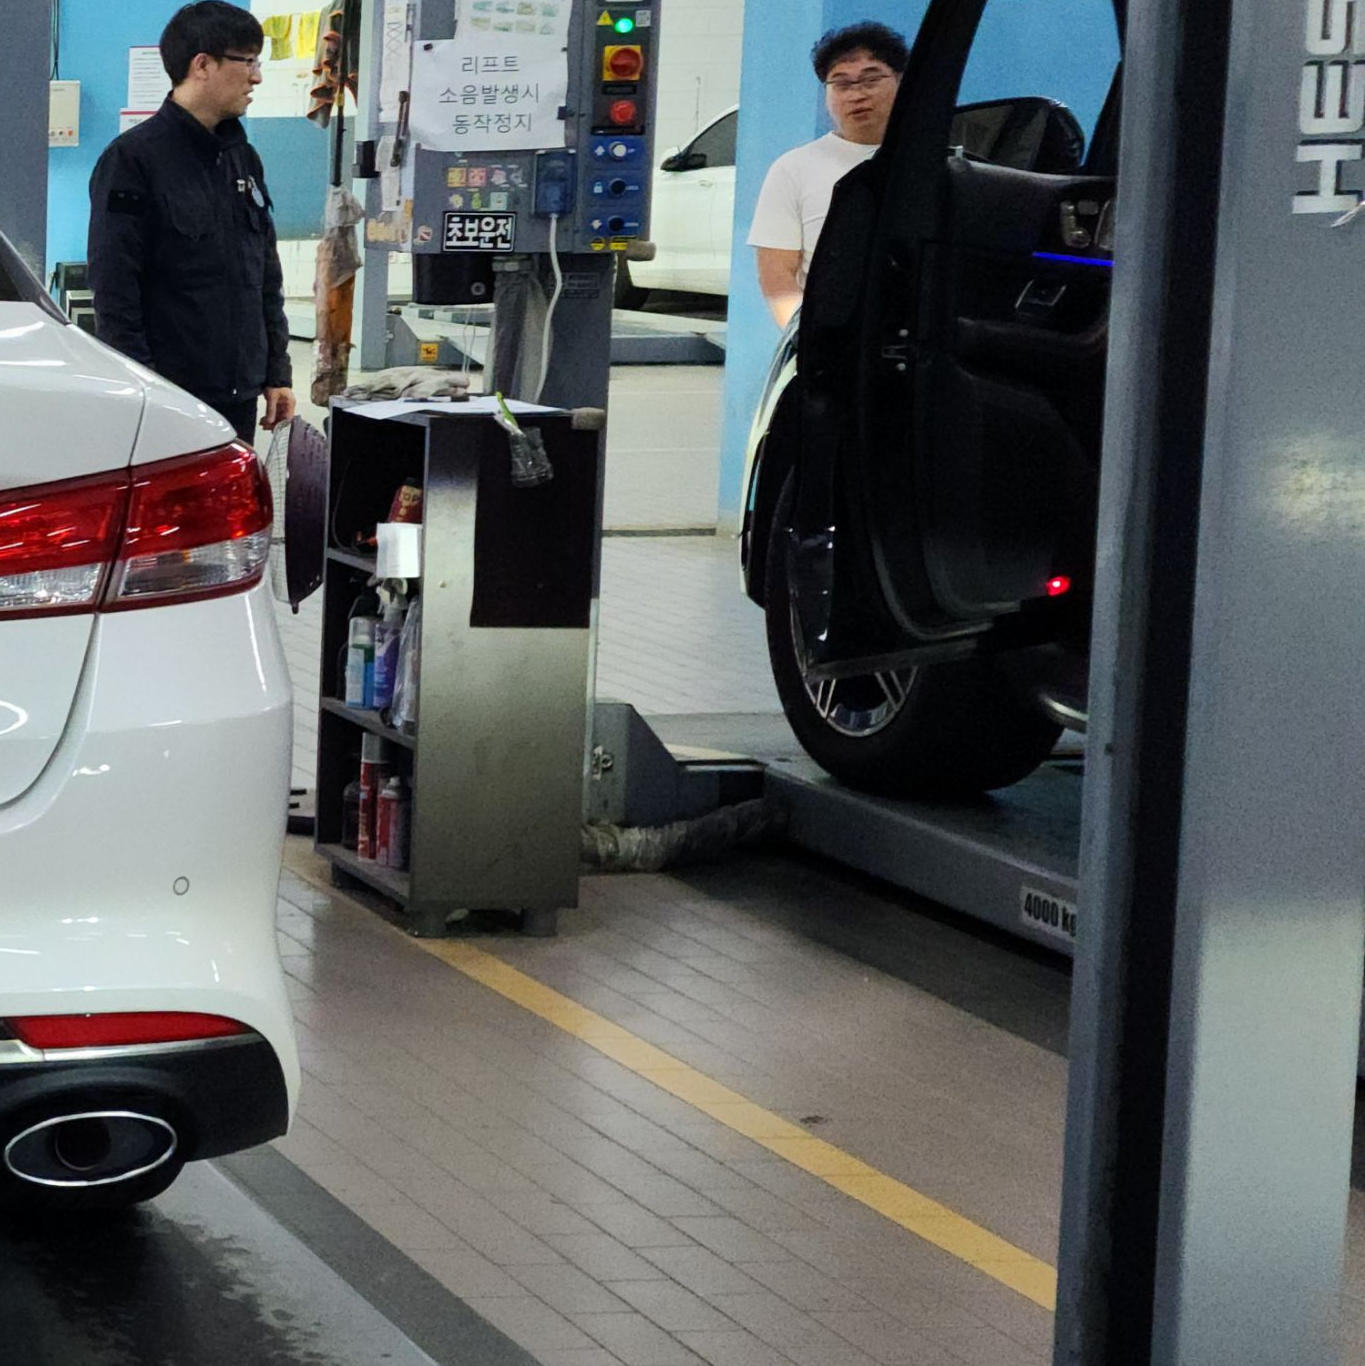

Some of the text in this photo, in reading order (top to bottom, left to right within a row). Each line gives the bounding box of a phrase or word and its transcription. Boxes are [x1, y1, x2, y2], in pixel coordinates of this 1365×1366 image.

[462, 56, 520, 75] 리프트
[439, 83, 539, 105] 소음발생시
[453, 113, 532, 134] 동작정지
[445, 216, 512, 248] 초보운전
[1024, 892, 1059, 927] 4000
